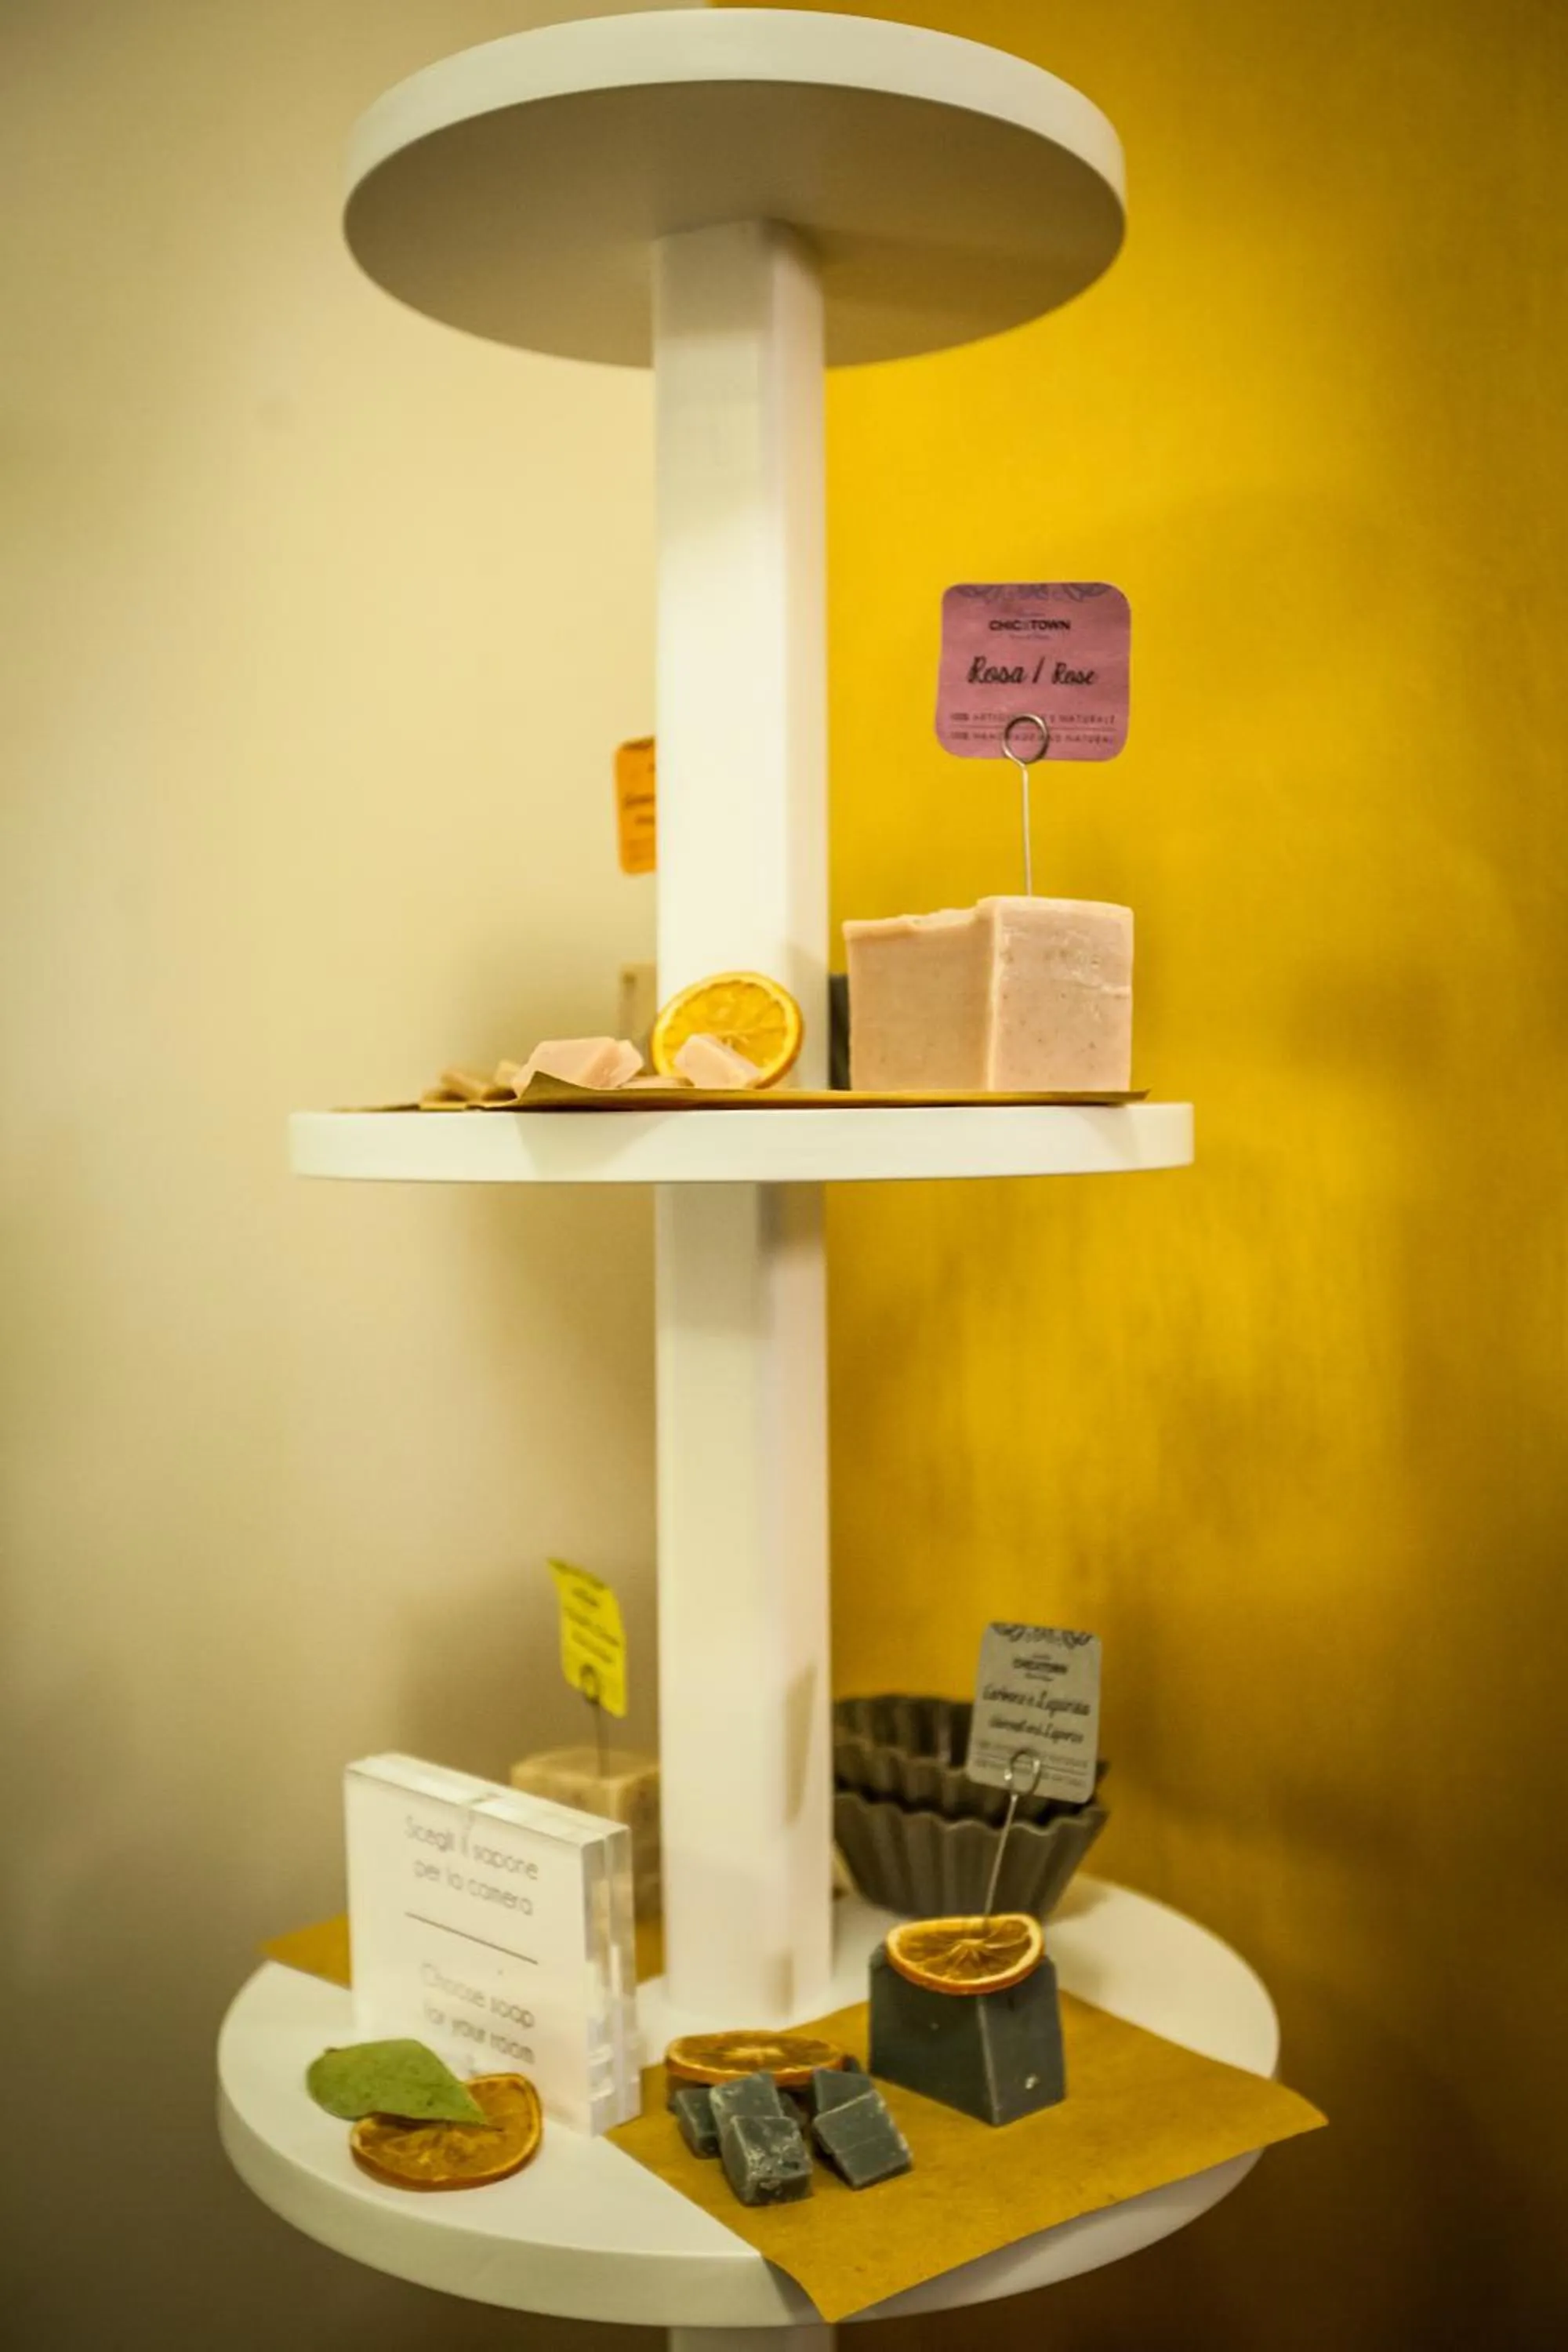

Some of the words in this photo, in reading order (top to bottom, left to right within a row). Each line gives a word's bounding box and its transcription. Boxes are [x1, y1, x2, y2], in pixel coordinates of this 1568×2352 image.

[967, 655, 1025, 684] Rosa
[1032, 656, 1046, 684] /
[1051, 662, 1095, 685] Rose
[473, 1843, 539, 1882] sapone
[467, 1878, 535, 1917] camera
[419, 1961, 486, 2008] Choose
[489, 1996, 535, 2030] soap
[451, 2017, 486, 2045] your
[489, 2031, 535, 2066] room
